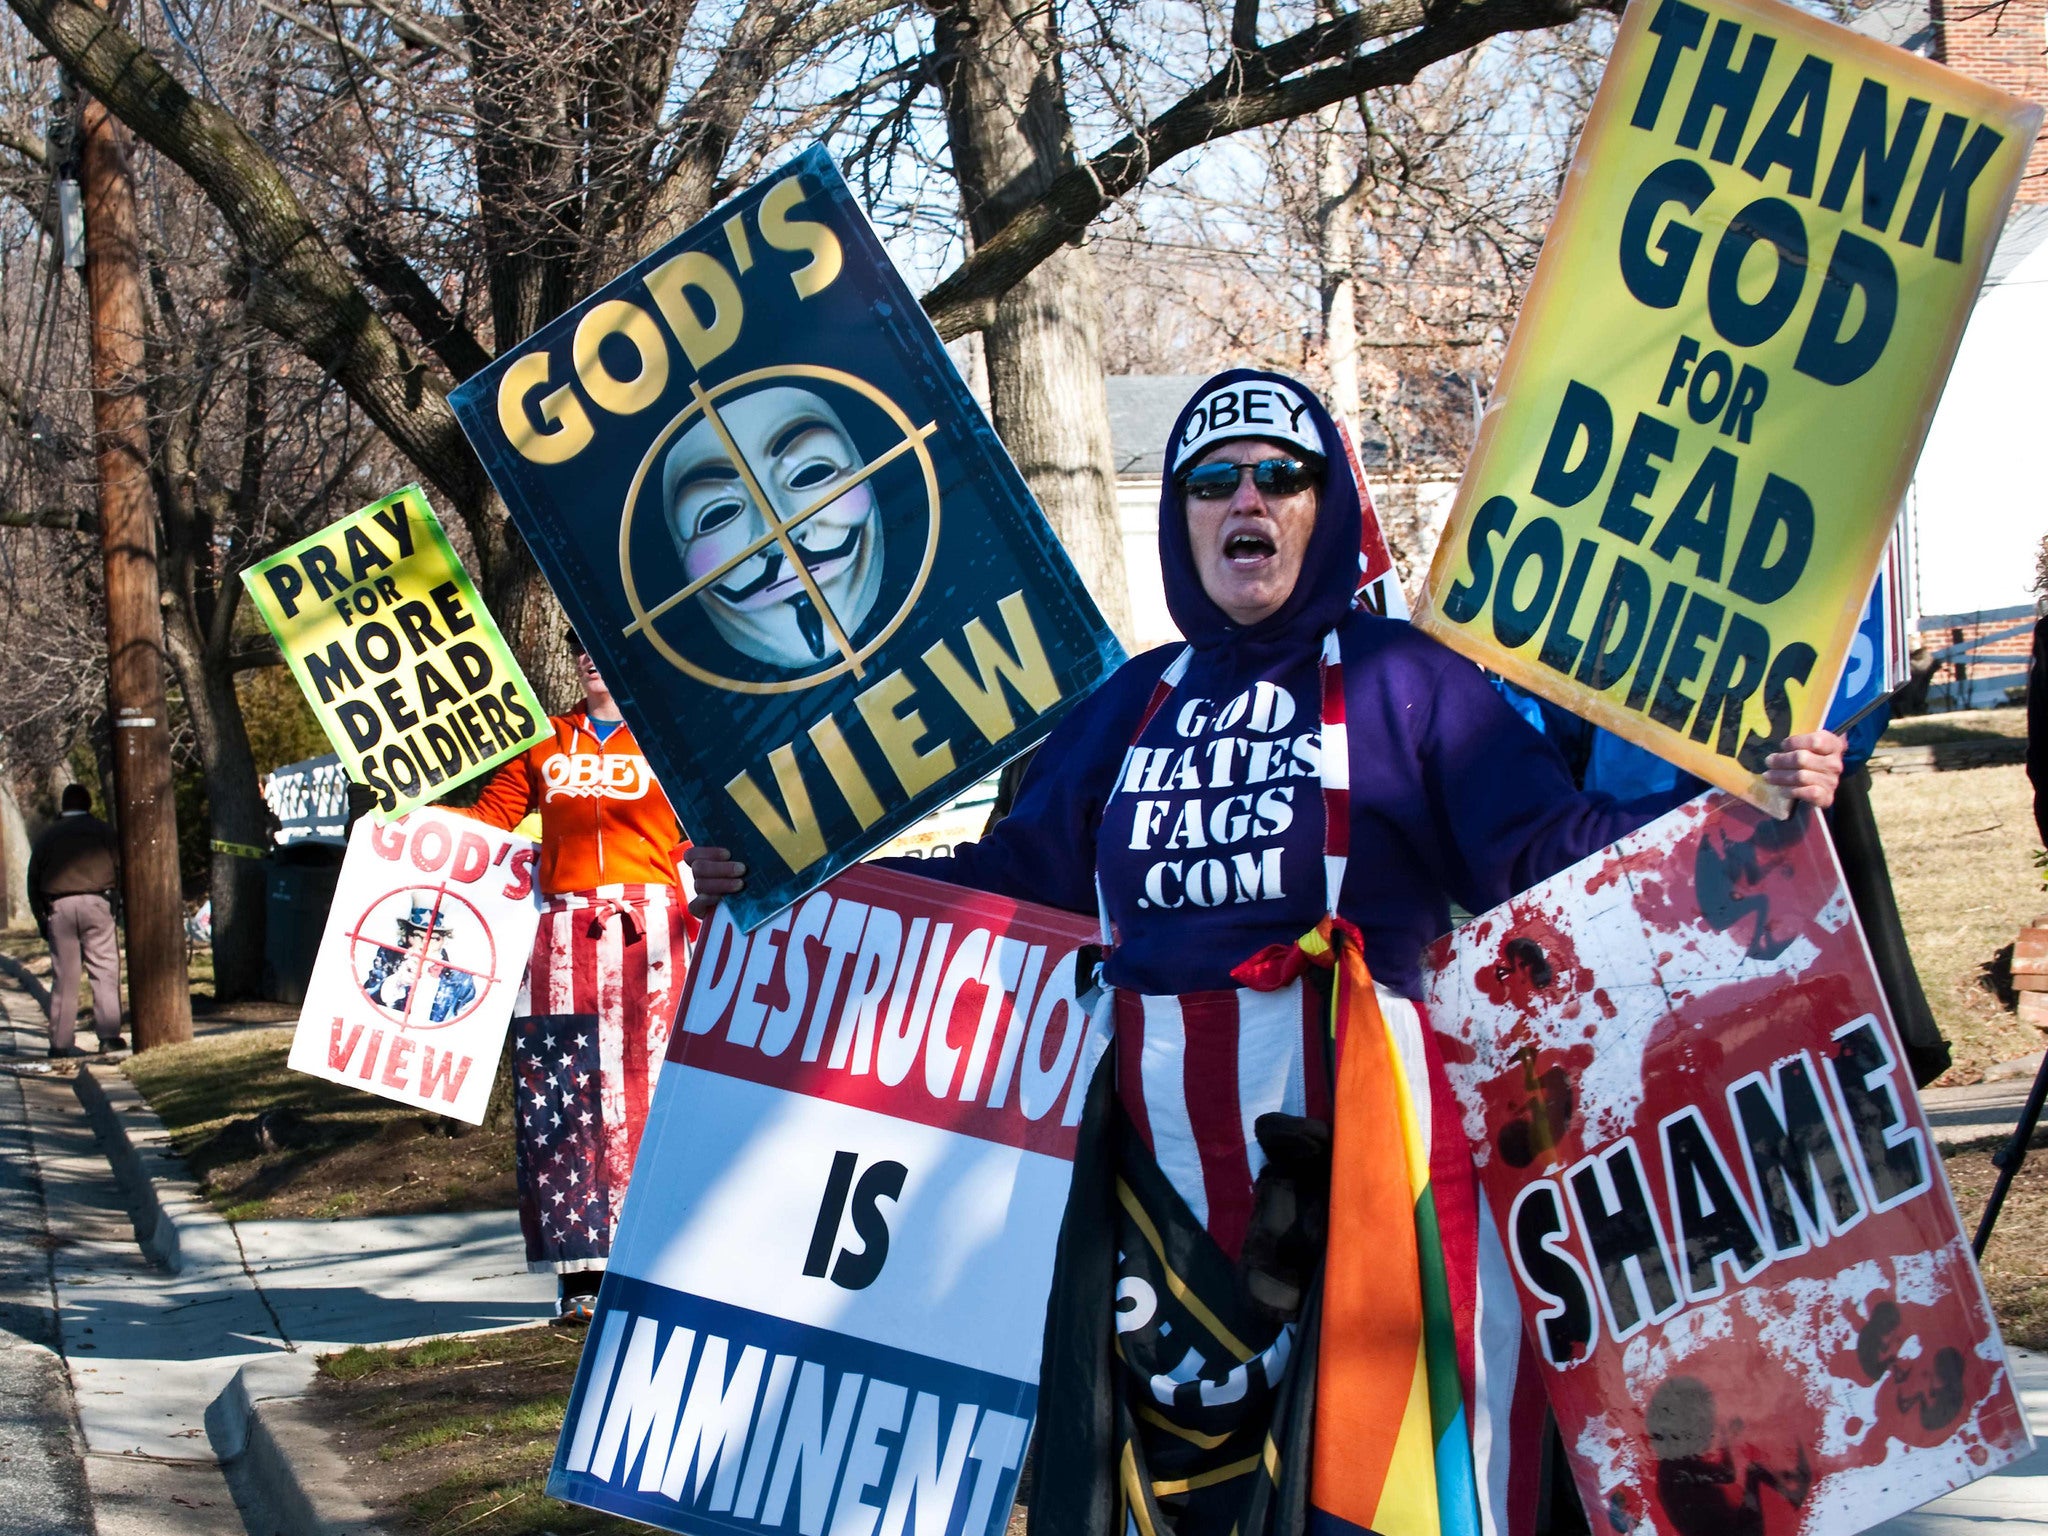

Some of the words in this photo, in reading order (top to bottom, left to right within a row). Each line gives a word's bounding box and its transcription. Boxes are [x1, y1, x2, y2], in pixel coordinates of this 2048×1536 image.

[1630, 0, 2005, 265] THANK
[497, 176, 844, 466] GOD'S
[1619, 158, 1899, 387] GOD
[1182, 389, 1307, 447] OBEY
[1658, 334, 1769, 445] FOR
[1530, 379, 1816, 605] DEAD
[264, 500, 415, 620] PRAY
[333, 574, 404, 627] FOR
[303, 580, 477, 704] MORE
[1442, 494, 1819, 776] SOLDIERS
[333, 641, 494, 754] DEAD
[361, 681, 538, 814] SOLDIERS
[723, 588, 1063, 876] VIEW
[1176, 680, 1297, 738] GOD
[541, 752, 658, 804] OBEY
[1120, 733, 1323, 794] HATES
[1127, 786, 1296, 851] FAGS
[371, 813, 542, 901] GOD'S
[1136, 847, 1287, 909] .COM
[326, 1016, 473, 1104] VIEW
[802, 1150, 909, 1292] IS
[1510, 1014, 1932, 1371] SHAME
[566, 1311, 1030, 1536] IMMINENT
